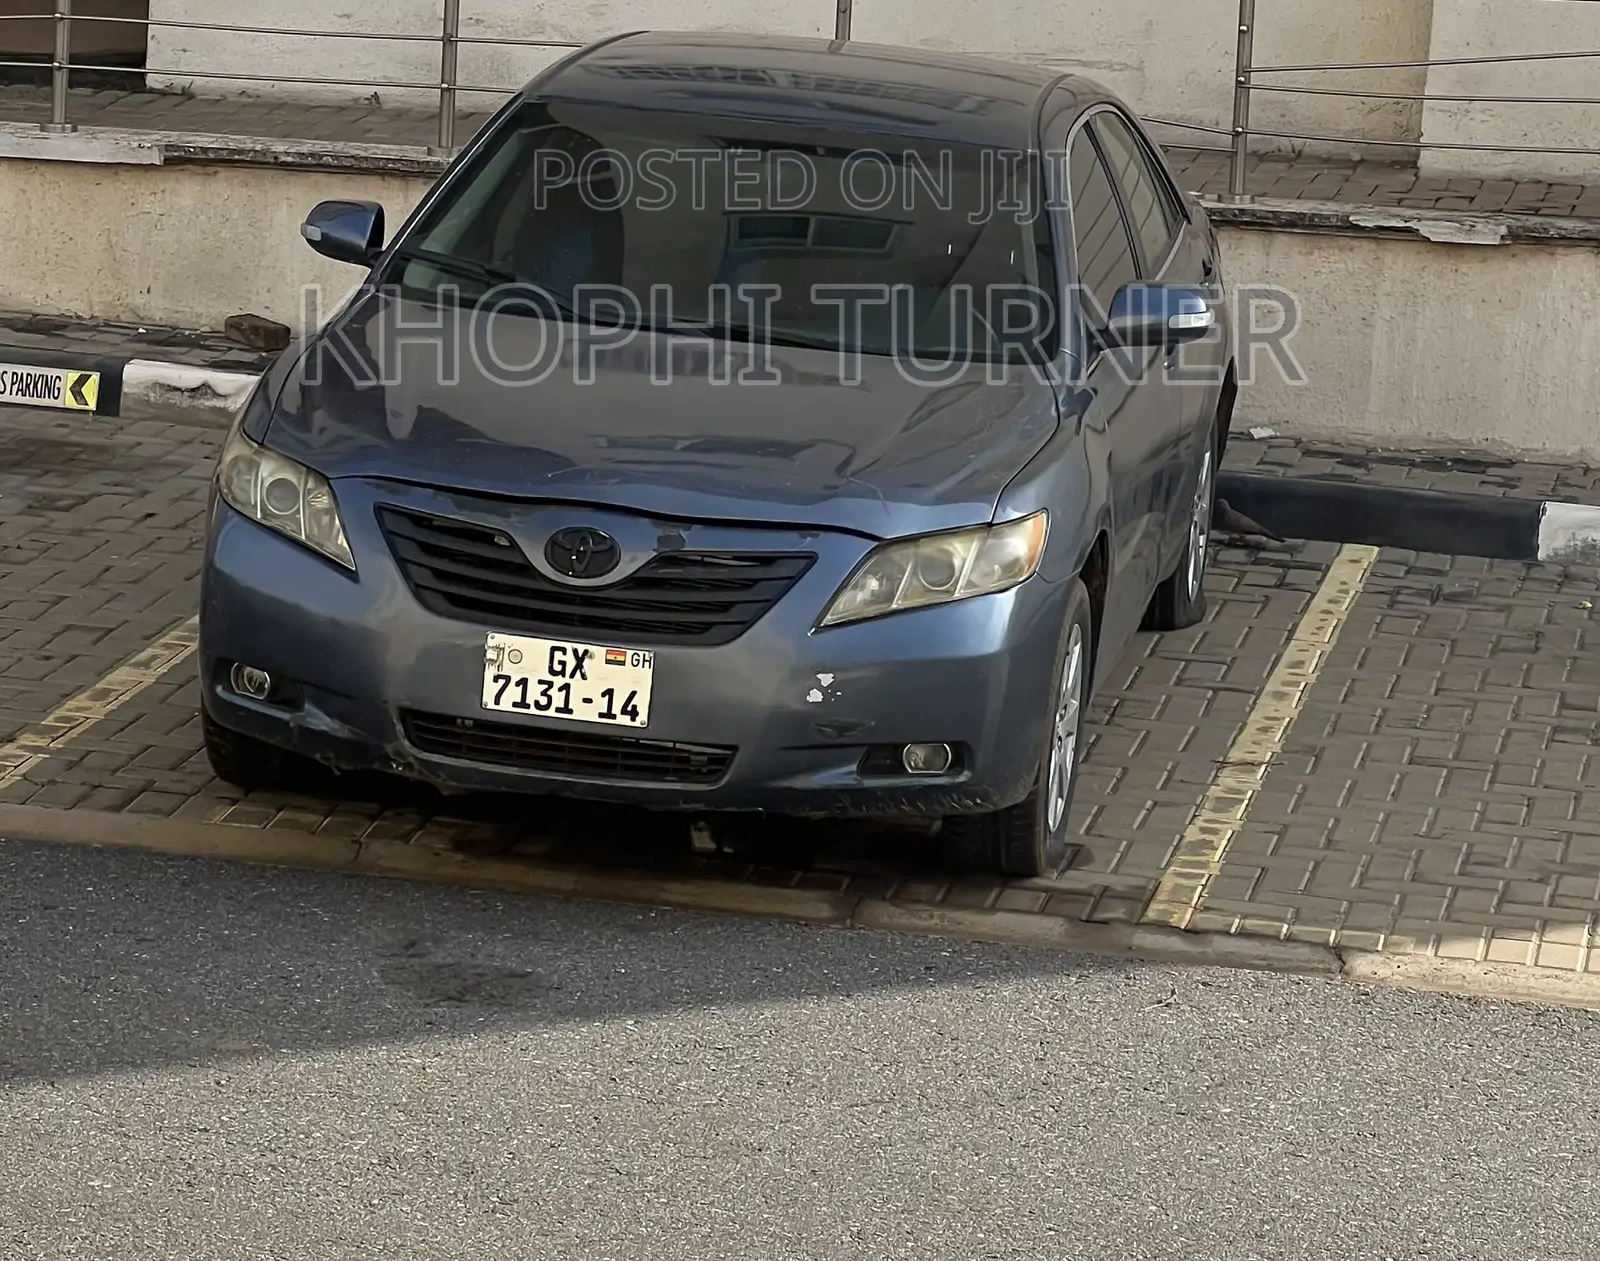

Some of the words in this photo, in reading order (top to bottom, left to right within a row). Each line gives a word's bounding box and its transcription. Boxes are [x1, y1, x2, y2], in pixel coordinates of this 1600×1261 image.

[9, 371, 62, 400] PARKING
[548, 645, 589, 680] GX
[630, 652, 652, 669] GH
[492, 674, 640, 723] 7131-14
